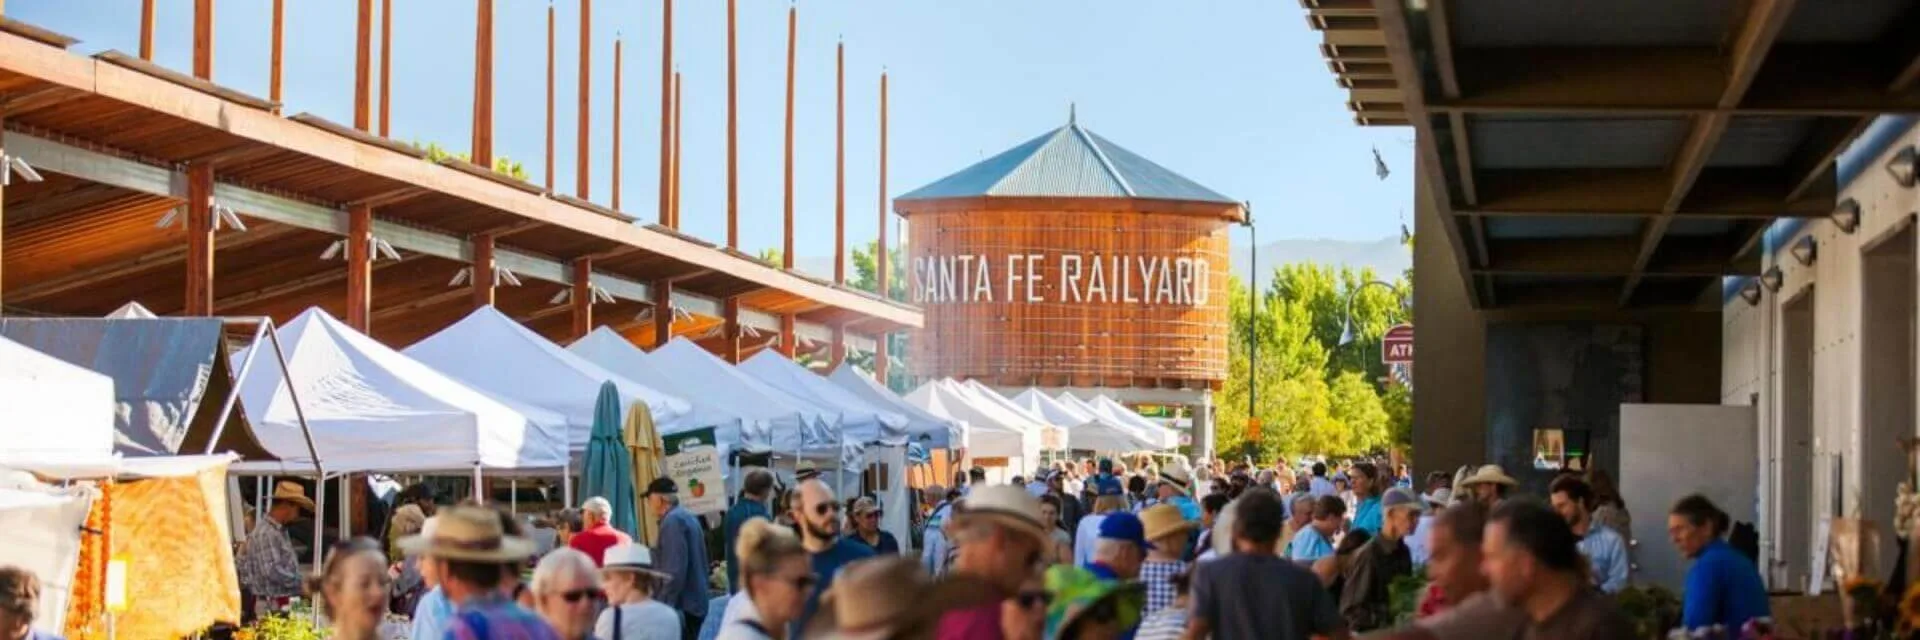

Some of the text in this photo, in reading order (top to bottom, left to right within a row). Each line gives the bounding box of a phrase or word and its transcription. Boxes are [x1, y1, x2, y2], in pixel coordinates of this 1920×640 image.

[914, 254, 1210, 305] SANTA FE RAILYARD
